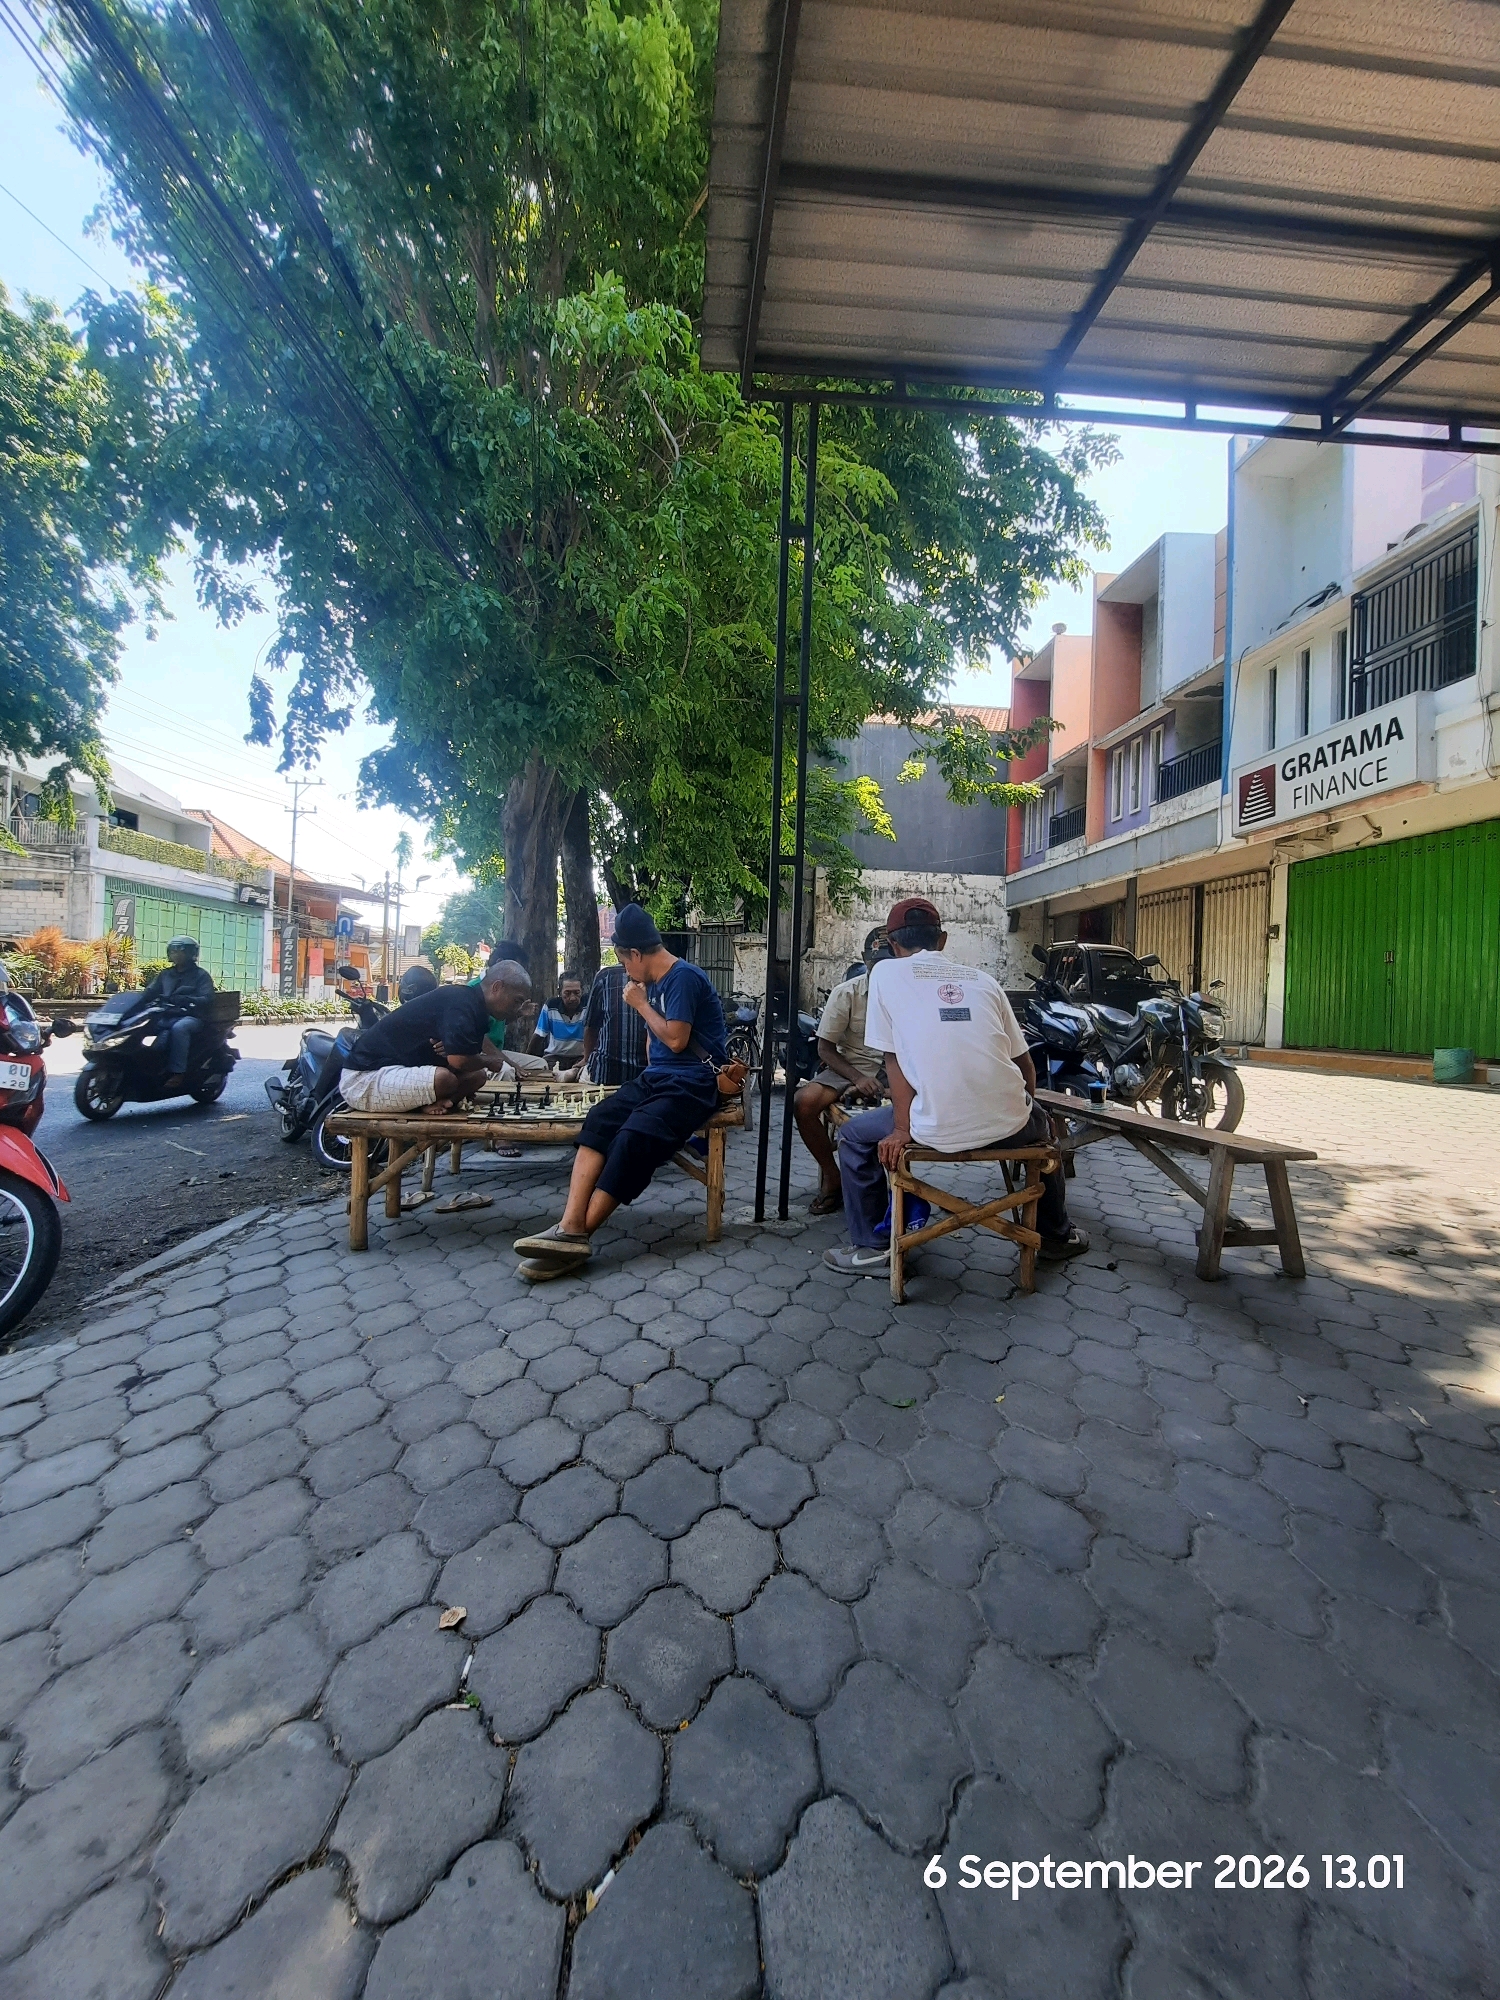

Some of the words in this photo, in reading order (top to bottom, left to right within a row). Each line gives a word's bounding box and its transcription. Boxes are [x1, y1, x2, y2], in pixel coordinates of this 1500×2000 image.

[1281, 716, 1404, 782] GRATAMA
[1293, 757, 1389, 810] FINANCE
[284, 938, 295, 972] SALEH
[283, 975, 293, 995] BAN
